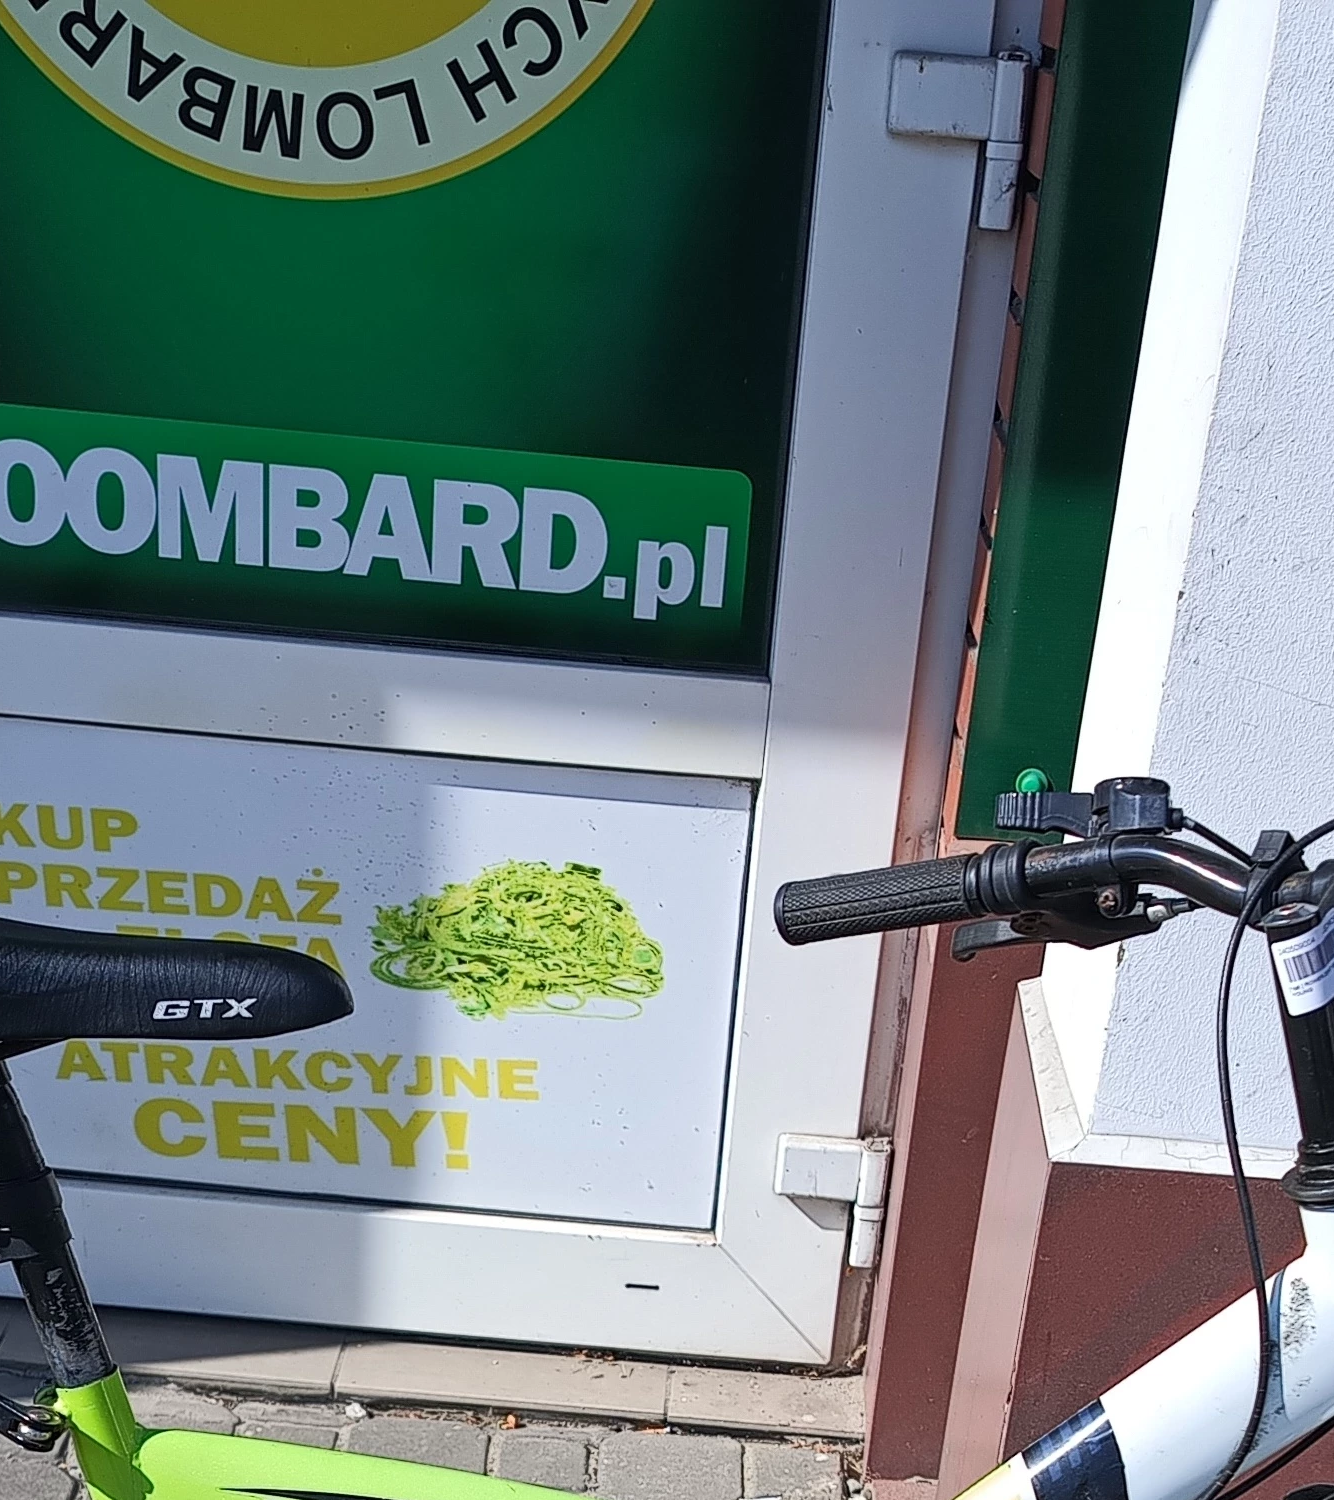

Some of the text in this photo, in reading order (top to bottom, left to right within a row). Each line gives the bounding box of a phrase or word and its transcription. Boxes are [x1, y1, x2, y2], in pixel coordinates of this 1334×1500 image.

[28, 0, 432, 160] LOMBAR
[152, 998, 257, 1020] GTX
[55, 1040, 540, 1103] ATRAKCYJNE
[132, 1097, 470, 1171] CENY!
